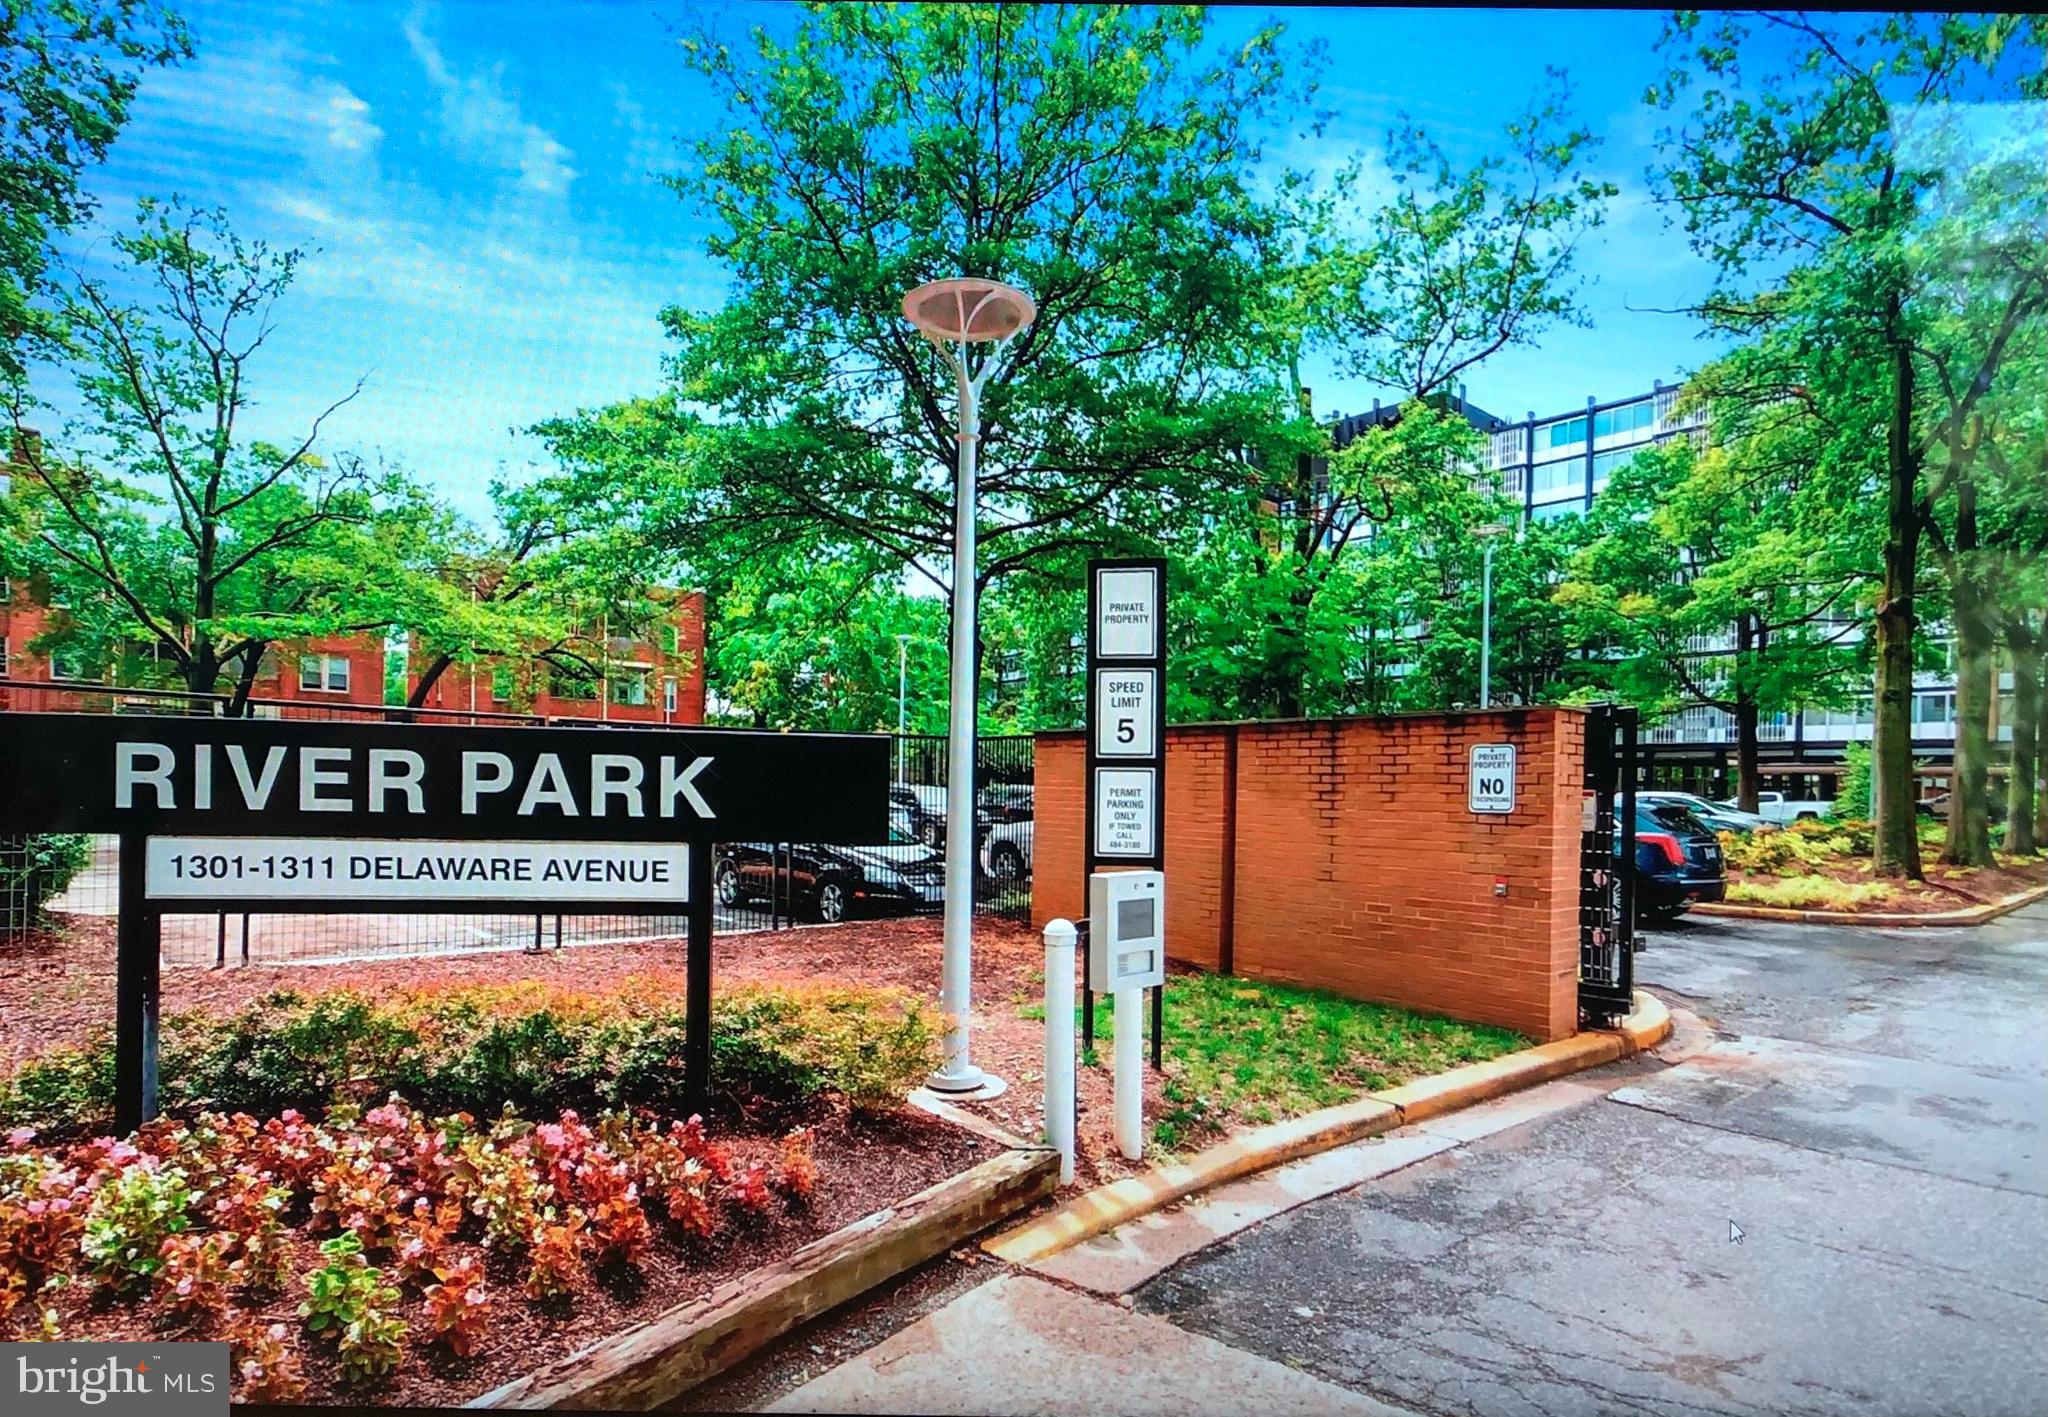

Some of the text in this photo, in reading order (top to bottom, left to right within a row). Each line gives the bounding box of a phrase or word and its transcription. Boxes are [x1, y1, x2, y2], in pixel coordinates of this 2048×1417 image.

[1109, 603, 1145, 612] PRIVATE
[1105, 614, 1150, 624] PROPERTY
[1109, 681, 1144, 693] SPEED
[1111, 697, 1142, 708] LIMIT
[1117, 718, 1135, 744] 5
[1474, 761, 1511, 769] PROPERTY
[115, 742, 717, 819] RIVER PARK
[1479, 778, 1505, 795] NO
[1109, 788, 1142, 797] PERMIT
[1107, 799, 1144, 809] PARKING
[1114, 811, 1136, 820] ONLY
[1117, 823, 1142, 831] TOWED
[1116, 832, 1134, 840] CALL
[170, 855, 669, 882] 1301-1311 DELAWARE AVENUE
